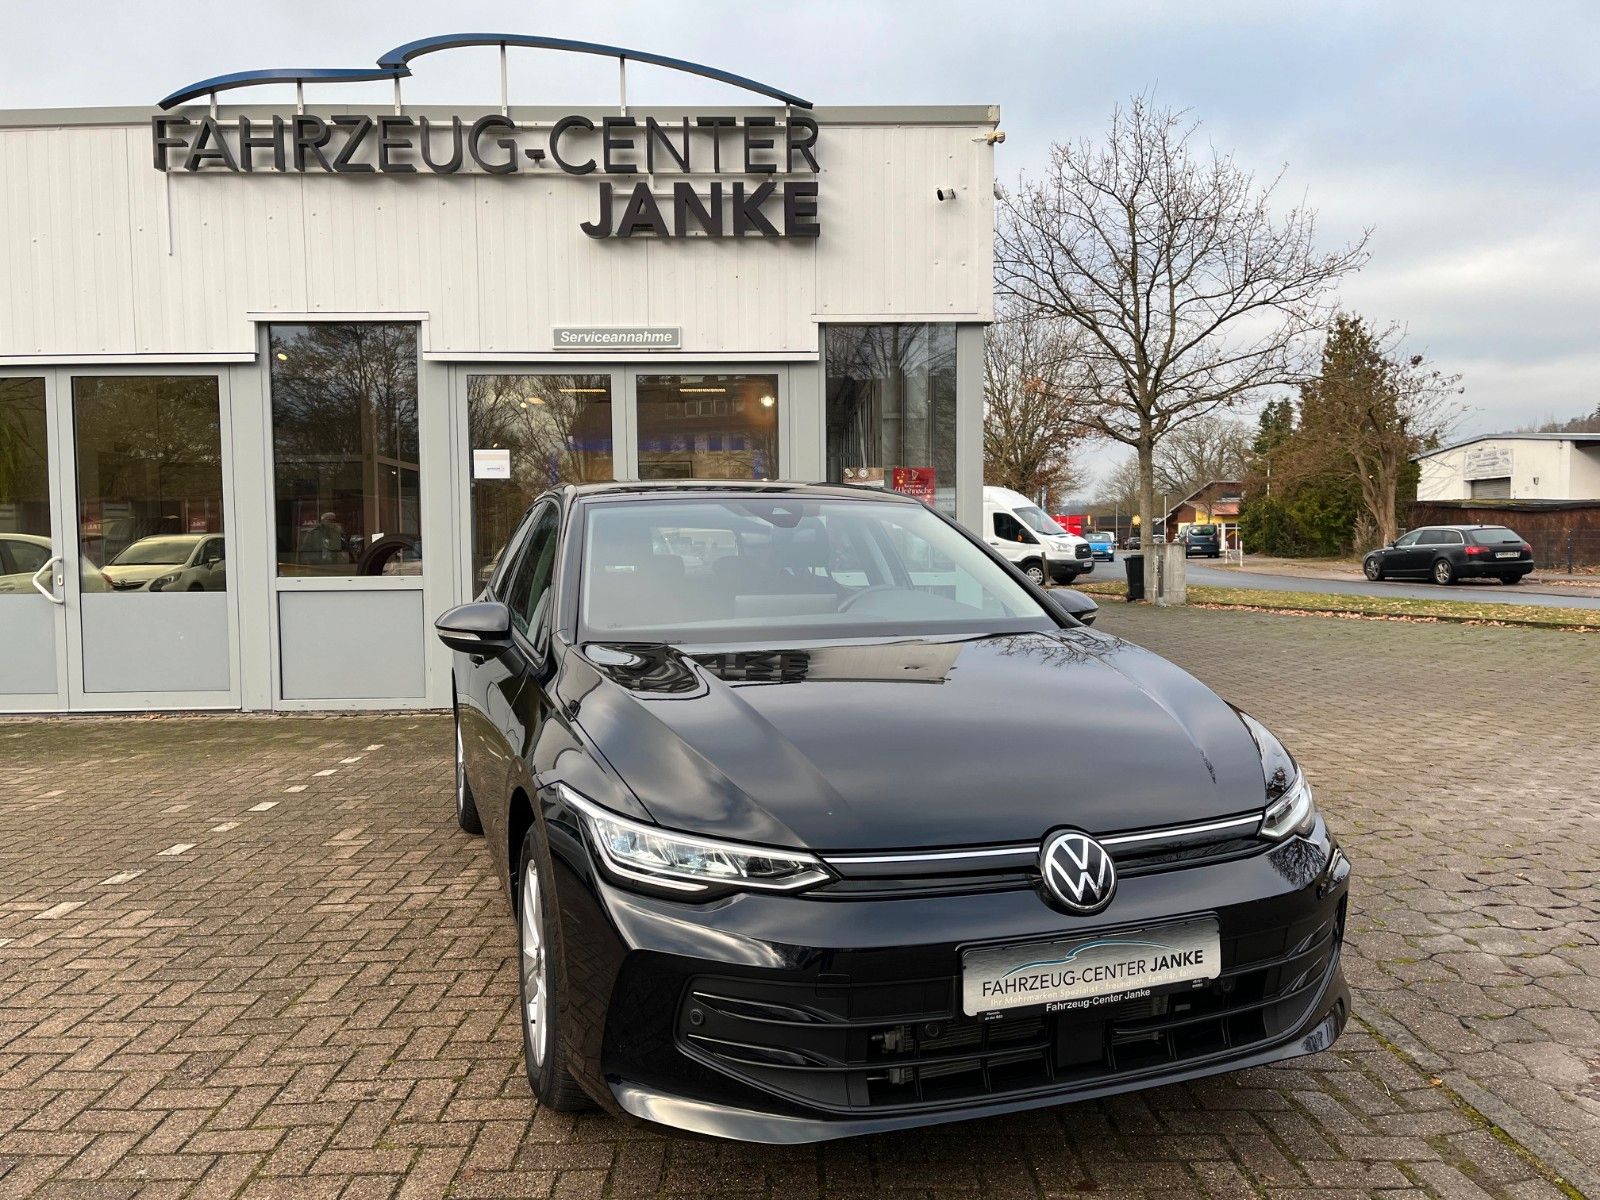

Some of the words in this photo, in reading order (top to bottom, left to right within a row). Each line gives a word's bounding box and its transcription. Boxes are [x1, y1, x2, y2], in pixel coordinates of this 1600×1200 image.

[152, 115, 820, 174] FAHRZEUG-CENTER
[580, 182, 820, 239] JANKE
[560, 331, 673, 343] Serviceannahme
[982, 959, 1146, 997] FAHRZEUG-CENTER
[1150, 950, 1204, 973] JANKE
[991, 998, 1003, 1007] Ihr
[1004, 991, 1058, 1005] Mehrmarken
[1060, 985, 1098, 999] Spezialist
[1046, 994, 1123, 1012] Fahrzeug-Center
[1124, 989, 1151, 1000] Janke
